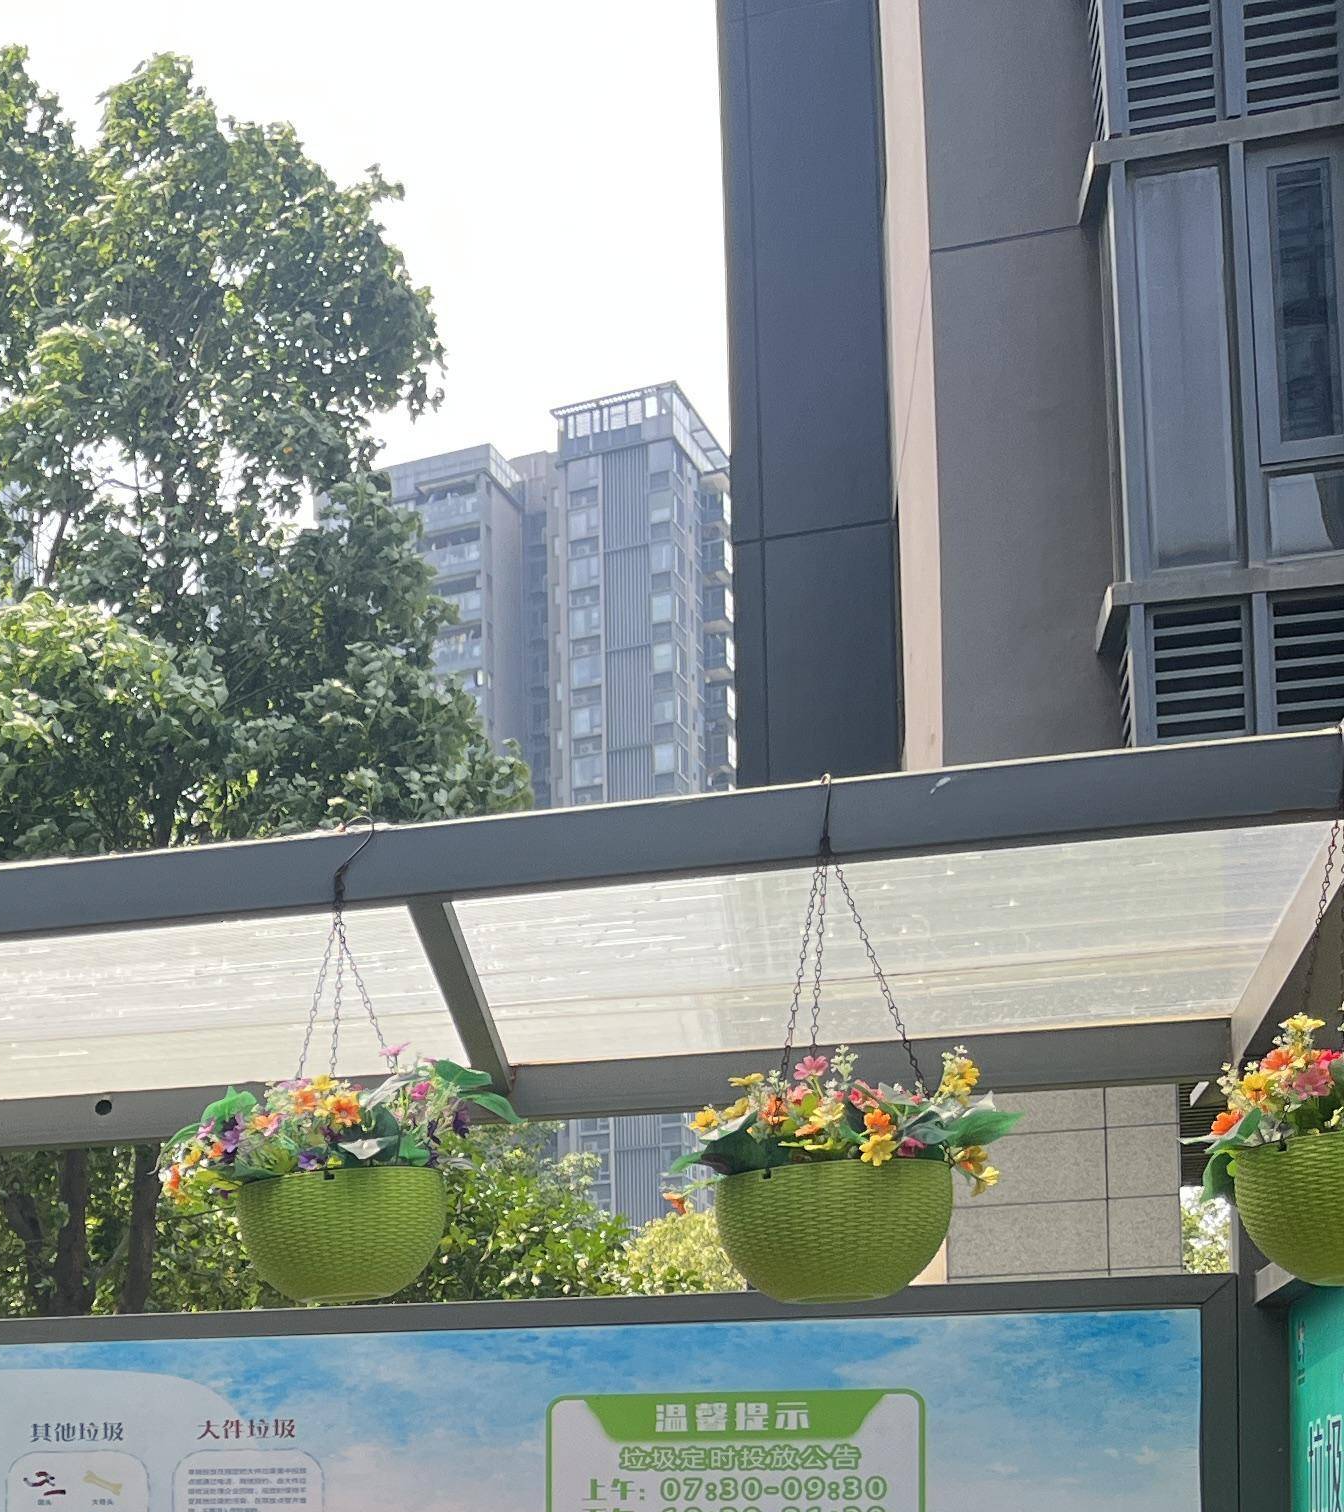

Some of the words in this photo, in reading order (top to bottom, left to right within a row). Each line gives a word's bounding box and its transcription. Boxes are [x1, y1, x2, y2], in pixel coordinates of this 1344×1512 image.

[655, 1401, 810, 1432] 温馨提示
[31, 1421, 125, 1443] 其他垃圾
[196, 1418, 297, 1441] 大件垃圾
[619, 1444, 862, 1471] 垃圾定时投放公告
[661, 1476, 887, 1501] 07:30-09:30
